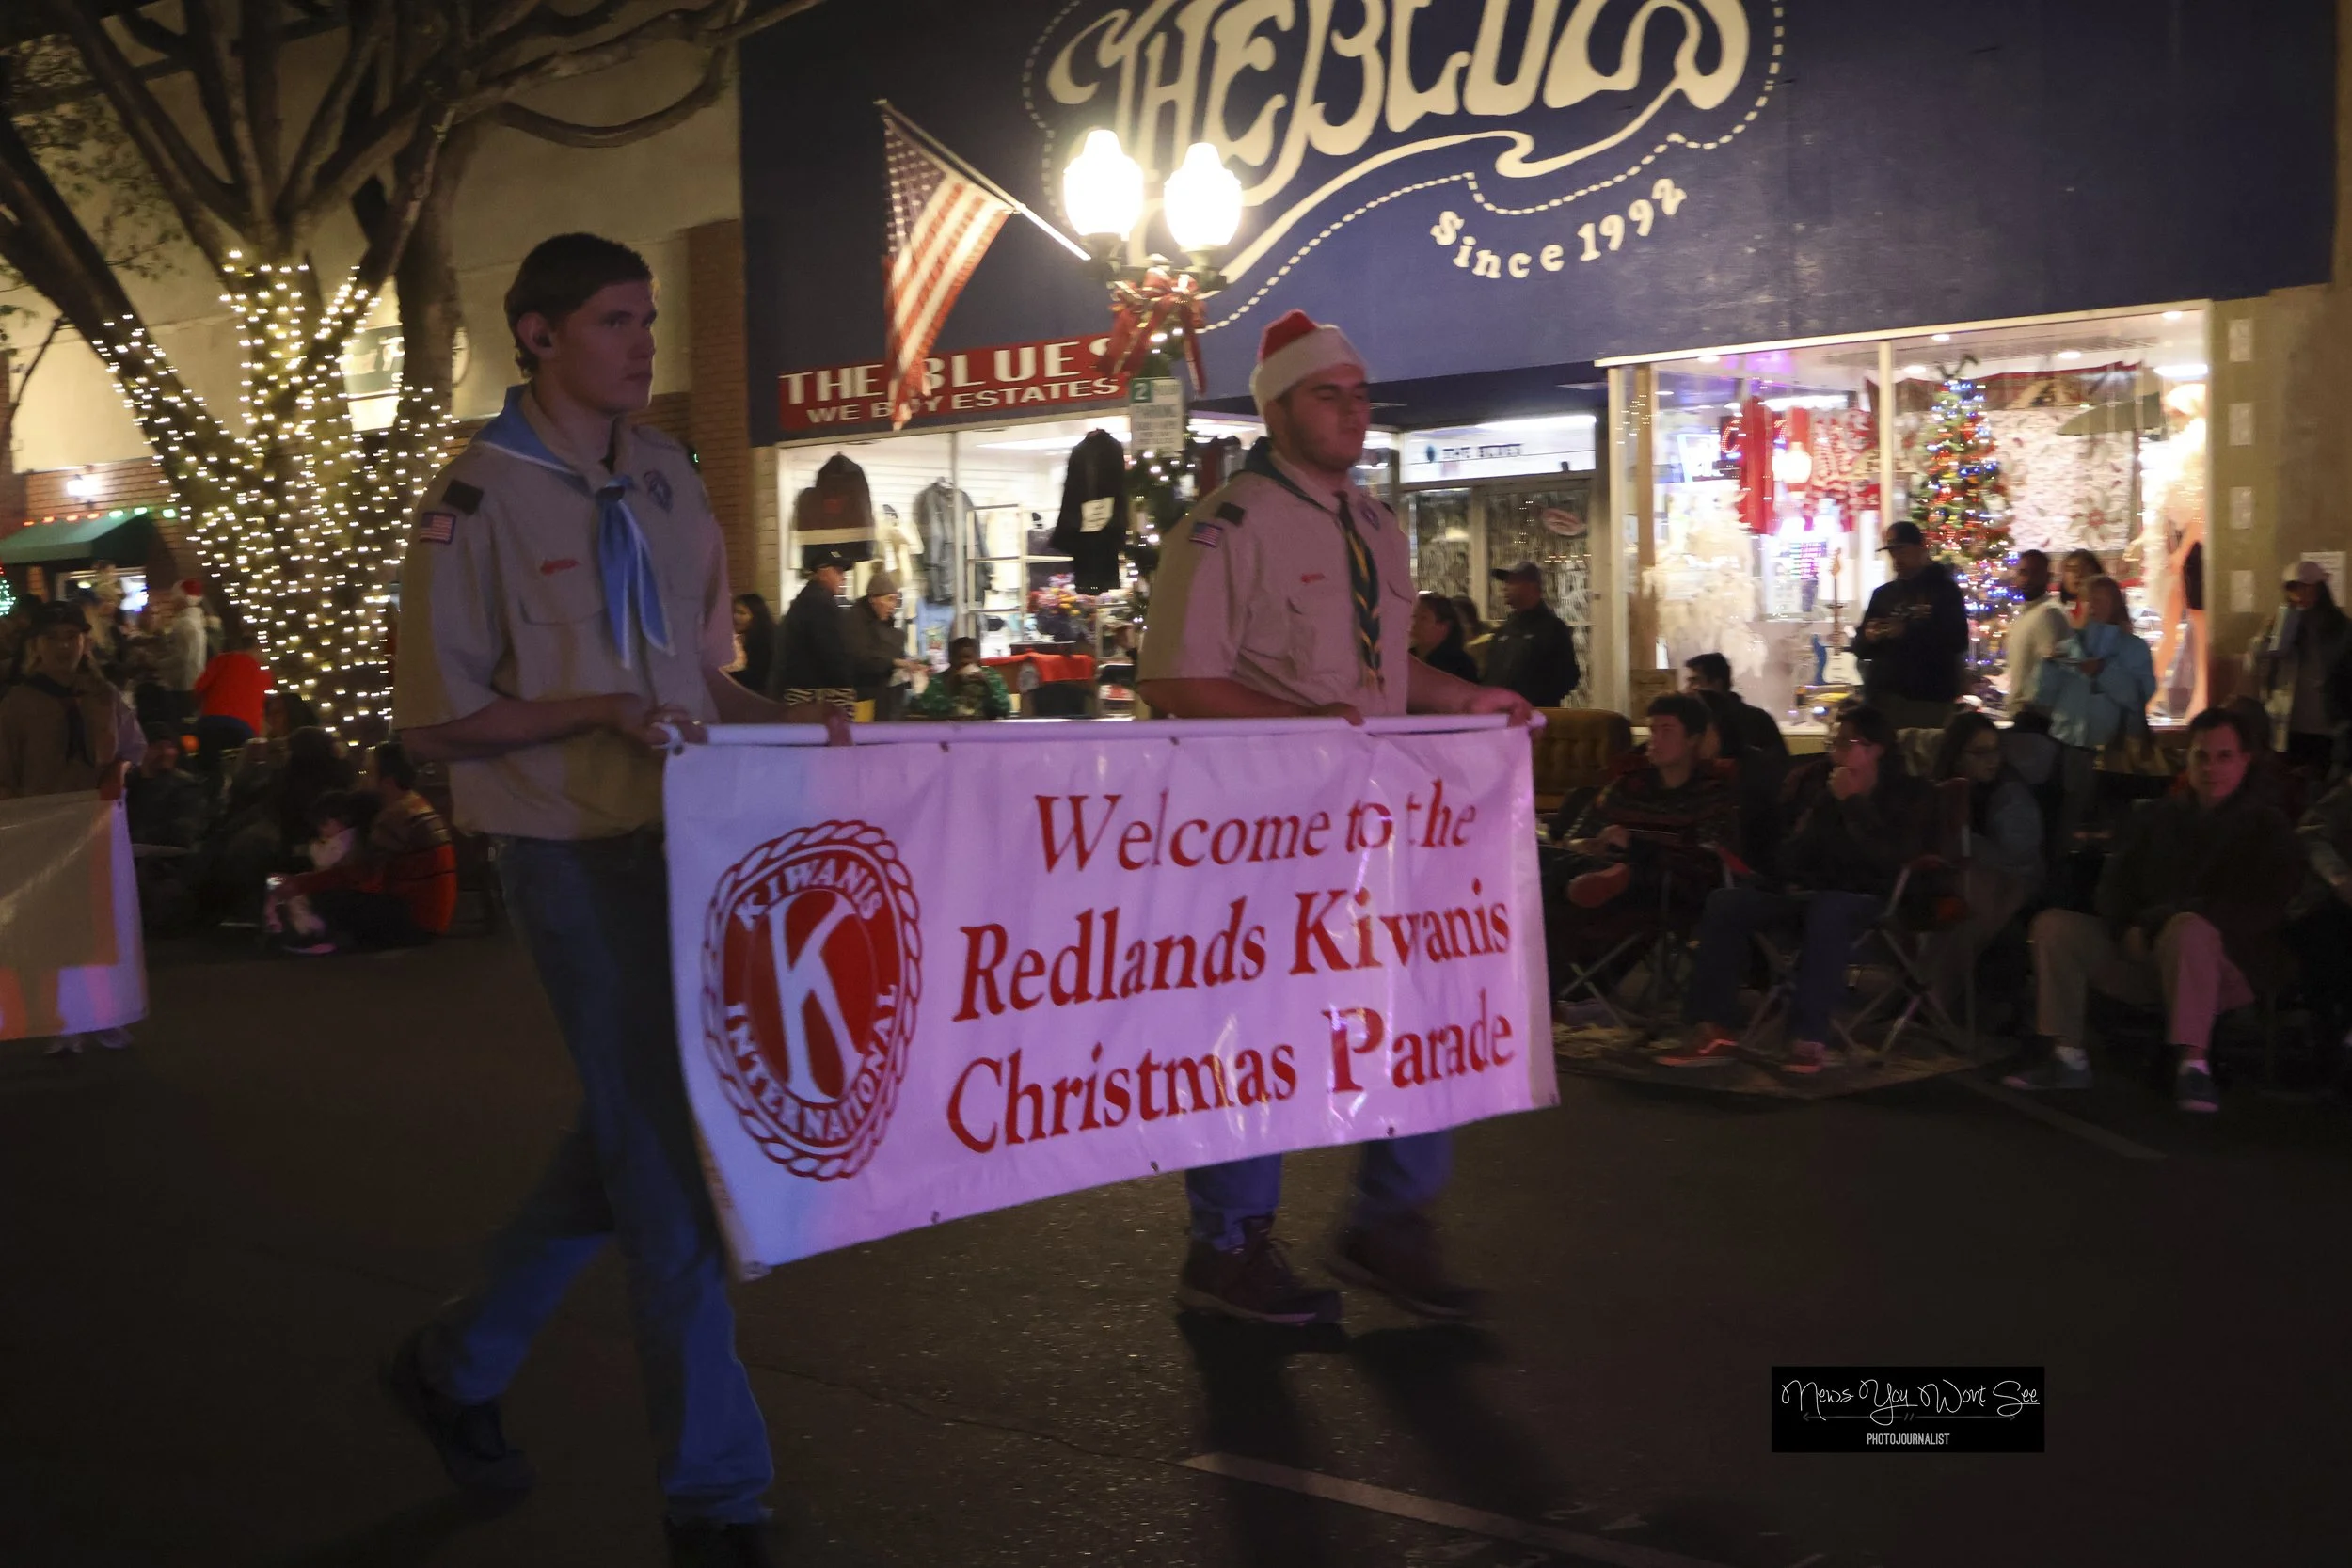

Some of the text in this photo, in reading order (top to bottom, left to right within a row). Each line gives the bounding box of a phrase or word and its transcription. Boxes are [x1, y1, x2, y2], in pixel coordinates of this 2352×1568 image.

[1430, 179, 1687, 278] Since 1992
[778, 364, 884, 404] THE
[806, 404, 861, 423] WE
[951, 377, 1120, 410] ESTATES
[1133, 382, 1149, 401] 2
[1035, 777, 1477, 874] Welcome to the
[734, 858, 883, 930] KIWANIS
[766, 889, 866, 1103] K
[952, 895, 1266, 1022] Redlands
[948, 988, 1515, 1153] Christmas Parade
